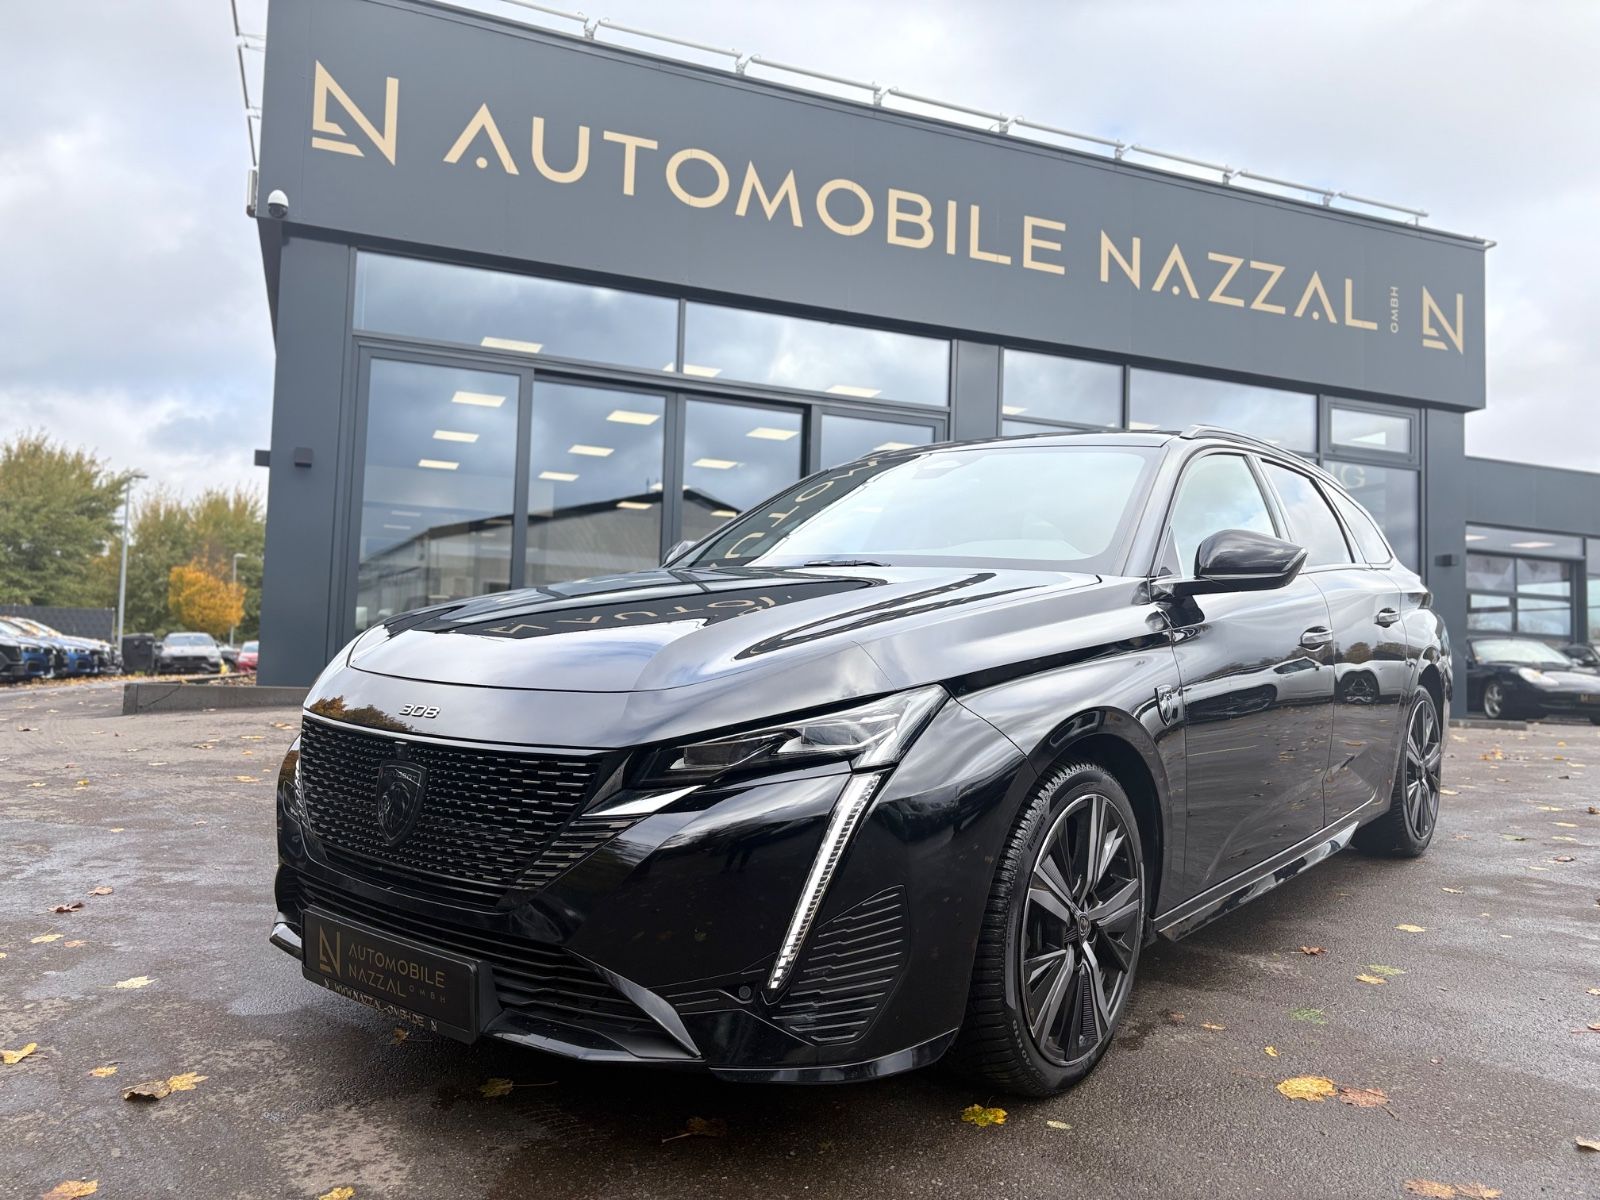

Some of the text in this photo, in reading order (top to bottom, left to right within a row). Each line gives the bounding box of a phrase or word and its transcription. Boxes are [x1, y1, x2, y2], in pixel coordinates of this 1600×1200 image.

[443, 103, 1066, 275] AUTOMOBILE
[1100, 229, 1378, 331] NAZZAL
[399, 703, 441, 718] 308
[348, 943, 446, 988] AUTOMOBILE
[348, 963, 407, 998] NAZZAL
